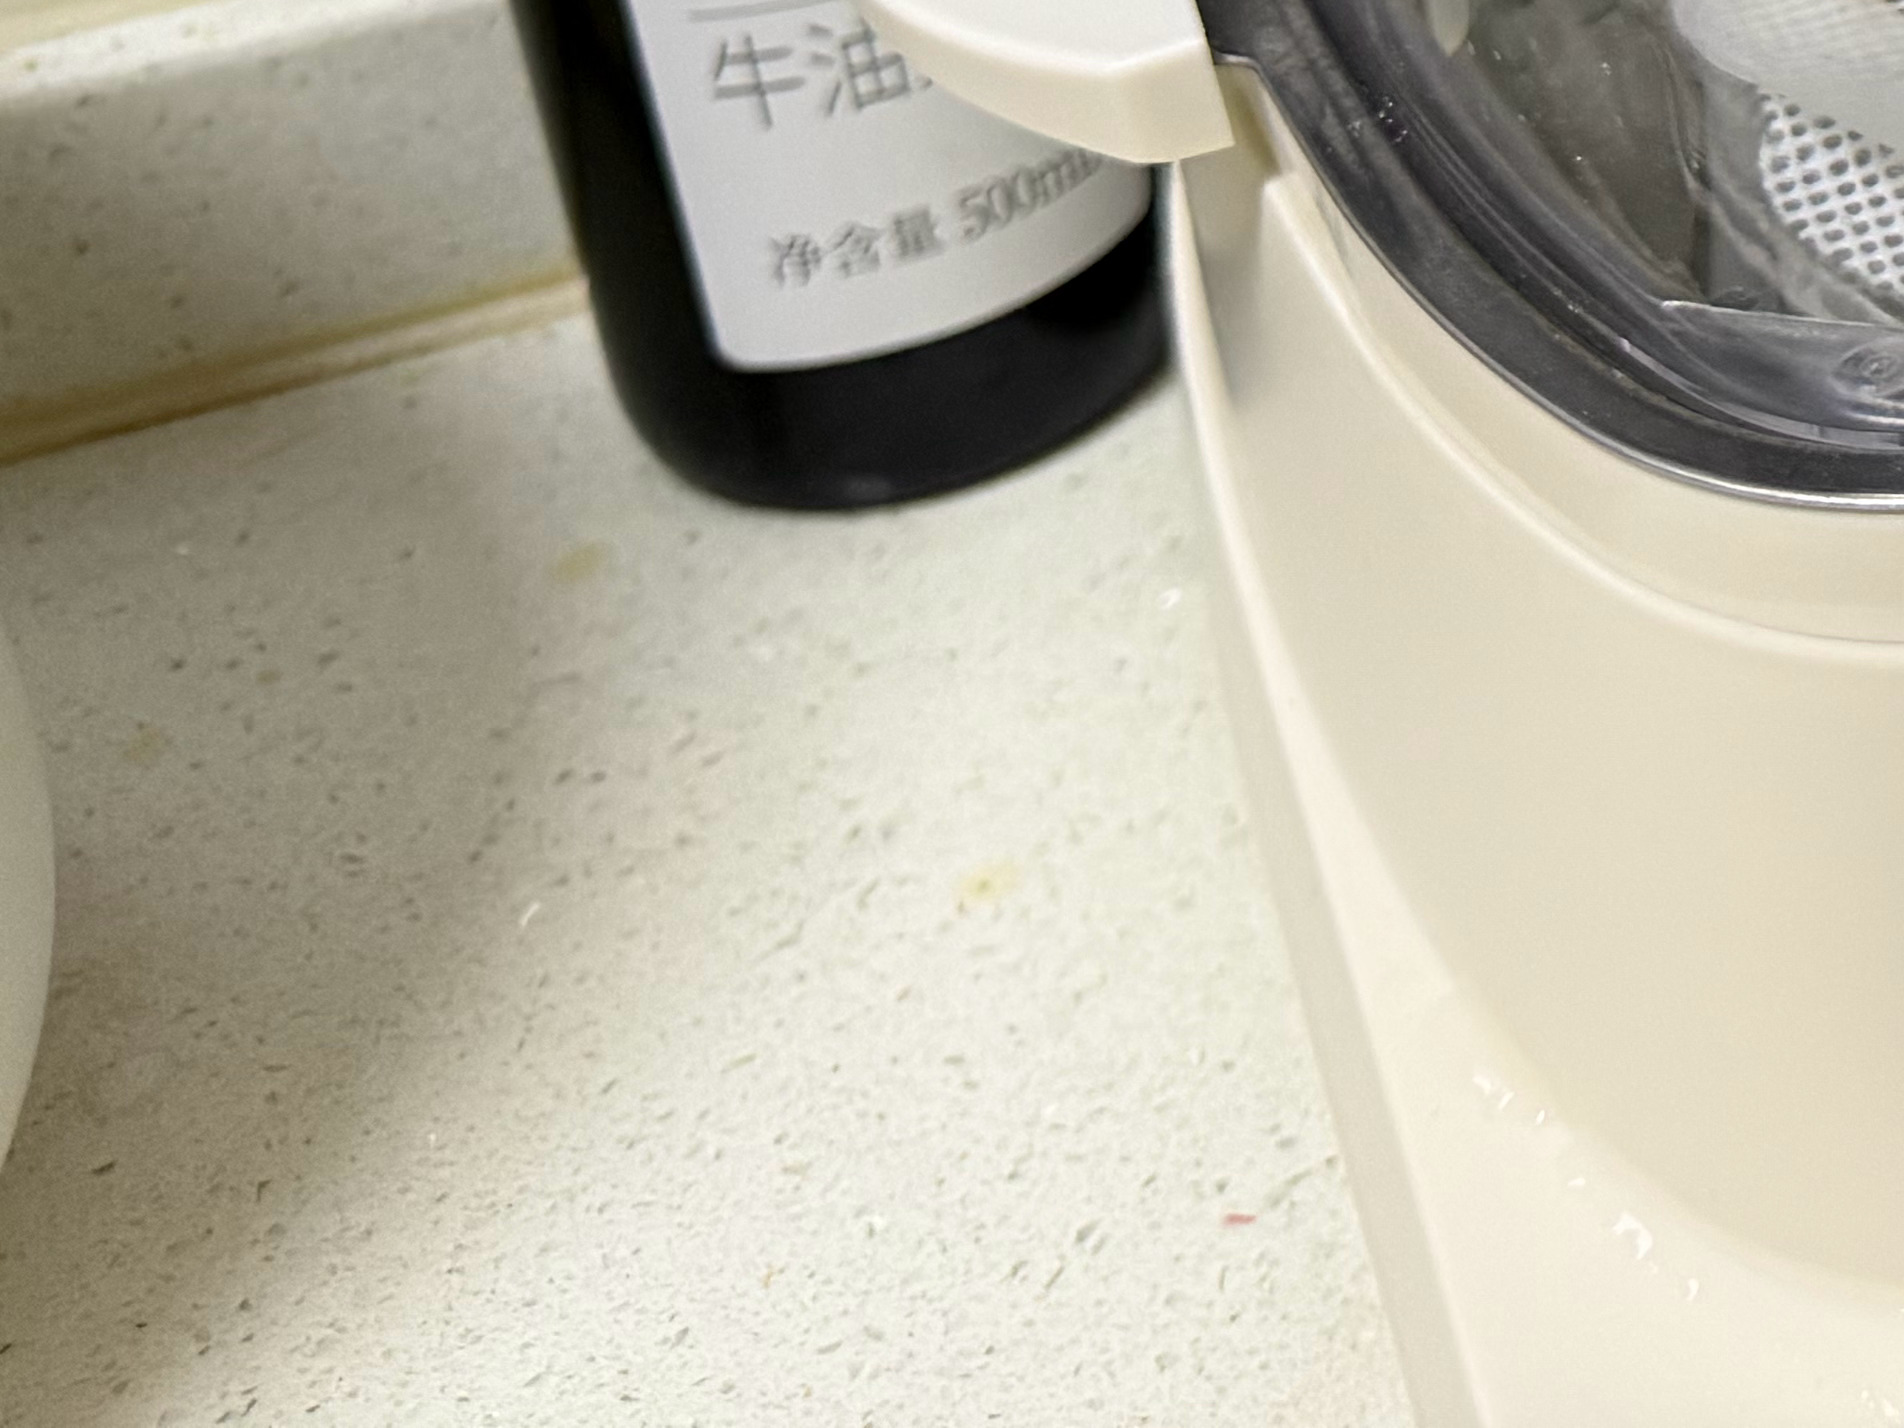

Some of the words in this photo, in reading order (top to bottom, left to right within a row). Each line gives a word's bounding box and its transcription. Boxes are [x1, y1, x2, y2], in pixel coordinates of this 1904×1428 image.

[712, 17, 934, 130] 牛油
[768, 204, 945, 289] 净含量
